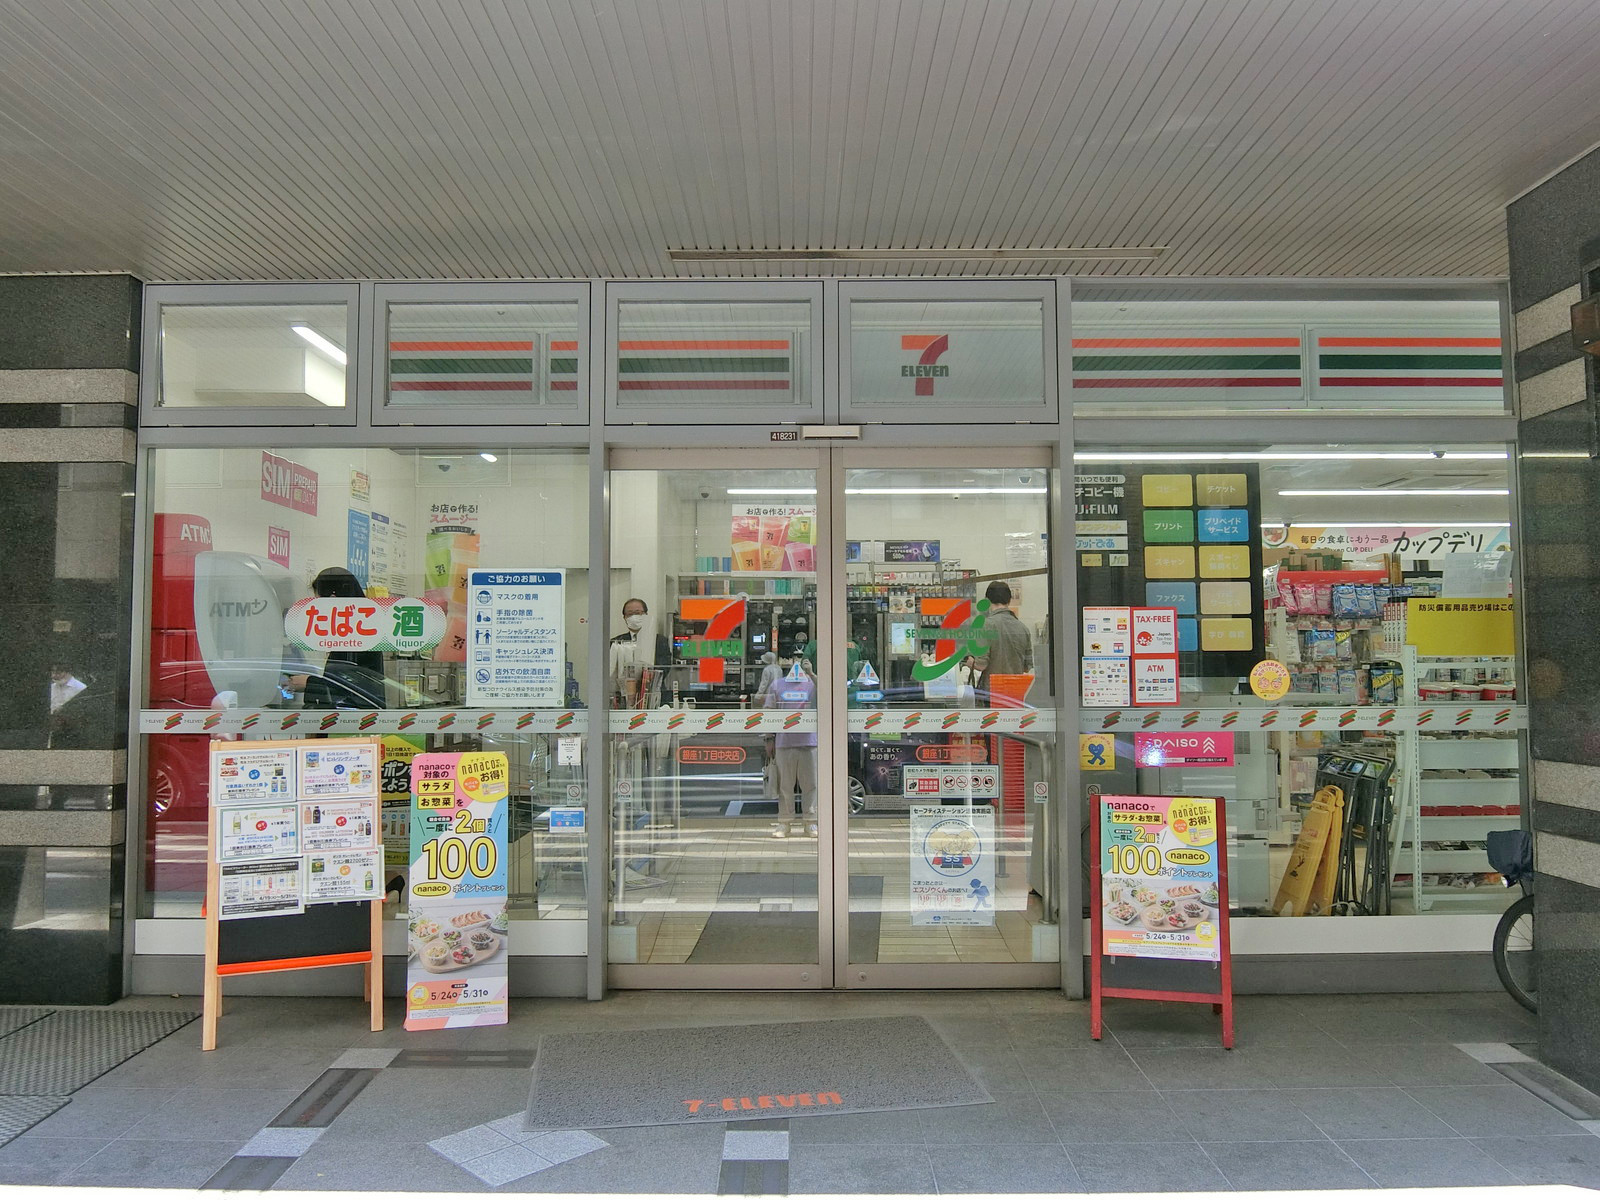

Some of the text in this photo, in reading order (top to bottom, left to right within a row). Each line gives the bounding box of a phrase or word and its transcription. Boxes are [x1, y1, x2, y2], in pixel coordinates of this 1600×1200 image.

[771, 432, 796, 441] 418231
[262, 460, 291, 500] SIM
[294, 473, 317, 493] PREPAID
[301, 490, 316, 506] DATA
[430, 514, 478, 525] スムージー
[1204, 517, 1242, 525] プリペイド
[1154, 522, 1183, 530] プリント
[1207, 526, 1239, 534] サービス
[270, 535, 289, 557] SIM
[1300, 530, 1484, 554] 毎日の食卓にもう一品 カップデリ
[1155, 558, 1185, 566] スキャン
[487, 575, 546, 584] ご協力のお願い
[496, 593, 539, 601] マスクの着用
[1156, 594, 1186, 602] ファクス
[1418, 603, 1513, 612] 防災備蓄用品売り場はこの
[496, 609, 533, 617] 手指の除菌
[305, 604, 425, 638] たばこ 酒
[495, 628, 557, 636] ソーシャルディスタンス
[318, 637, 425, 649] cigarette liquor
[495, 647, 554, 655] キャッシュレス決済
[1146, 664, 1165, 673] ATM
[1153, 738, 1199, 748] DAISO
[682, 749, 740, 761] 銀座1丁目中央店
[423, 770, 449, 779] 対象の
[480, 770, 504, 782] お得!
[422, 782, 451, 791] サラダ
[420, 797, 464, 807] お惣菜 を
[426, 823, 453, 833] 一度に
[455, 808, 486, 834] 2個
[1113, 813, 1161, 823] サラダ・お惣菜
[1188, 815, 1211, 827] お得!
[422, 836, 497, 881] 100
[1108, 844, 1205, 876] 100 nanaco
[417, 885, 447, 893] nanaco
